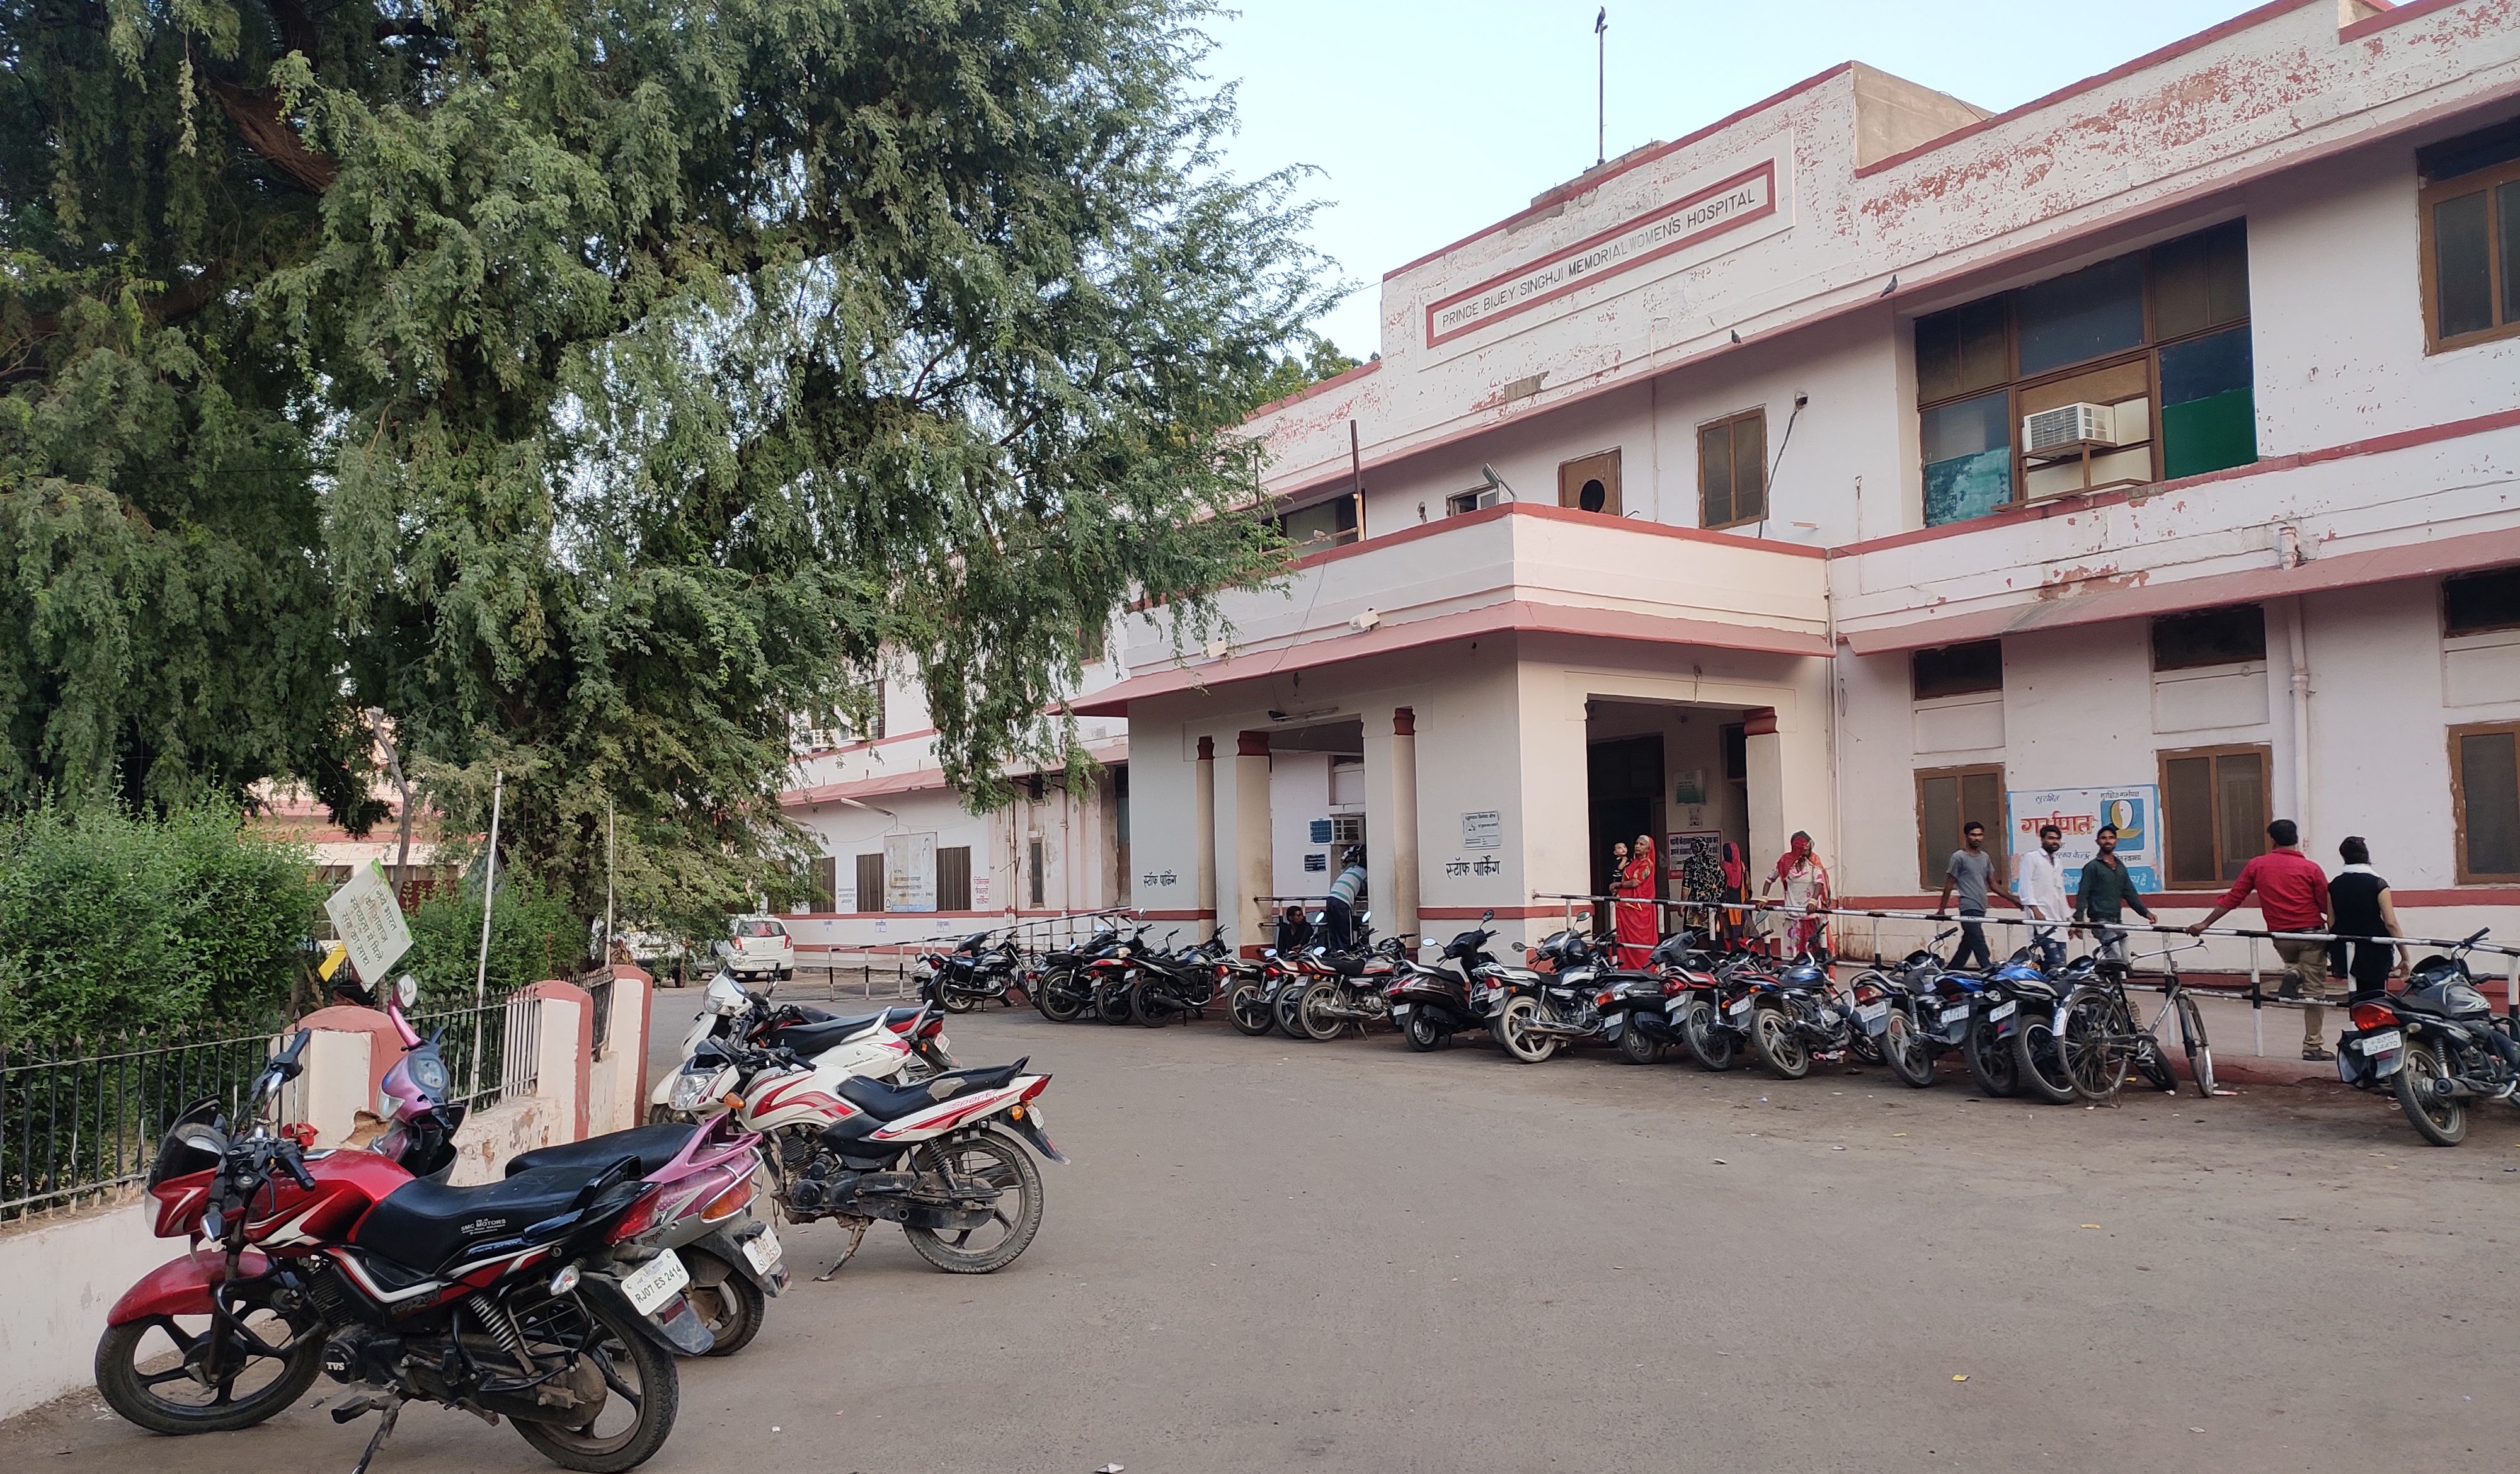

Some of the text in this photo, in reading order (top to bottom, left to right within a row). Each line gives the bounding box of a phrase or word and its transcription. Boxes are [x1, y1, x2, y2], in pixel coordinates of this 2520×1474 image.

[1442, 188, 1756, 328] PRINCE BIJEY SINGHJI MEMORIAL WOMEN'S HOSPITAL
[1473, 855, 1500, 876] पार्किंग
[350, 895, 370, 934] स्वच्छता
[367, 930, 376, 942] में
[365, 894, 389, 943] की आवाज
[376, 888, 398, 932] नये भारत
[350, 928, 360, 945] का
[357, 944, 370, 966] साथ
[461, 1223, 475, 1231] SMC
[476, 1219, 506, 1228] MOTORS
[635, 1284, 655, 1303] RJ07
[654, 1277, 666, 1290] ES
[665, 1264, 682, 1283] 2414
[326, 1361, 345, 1371] TVS
